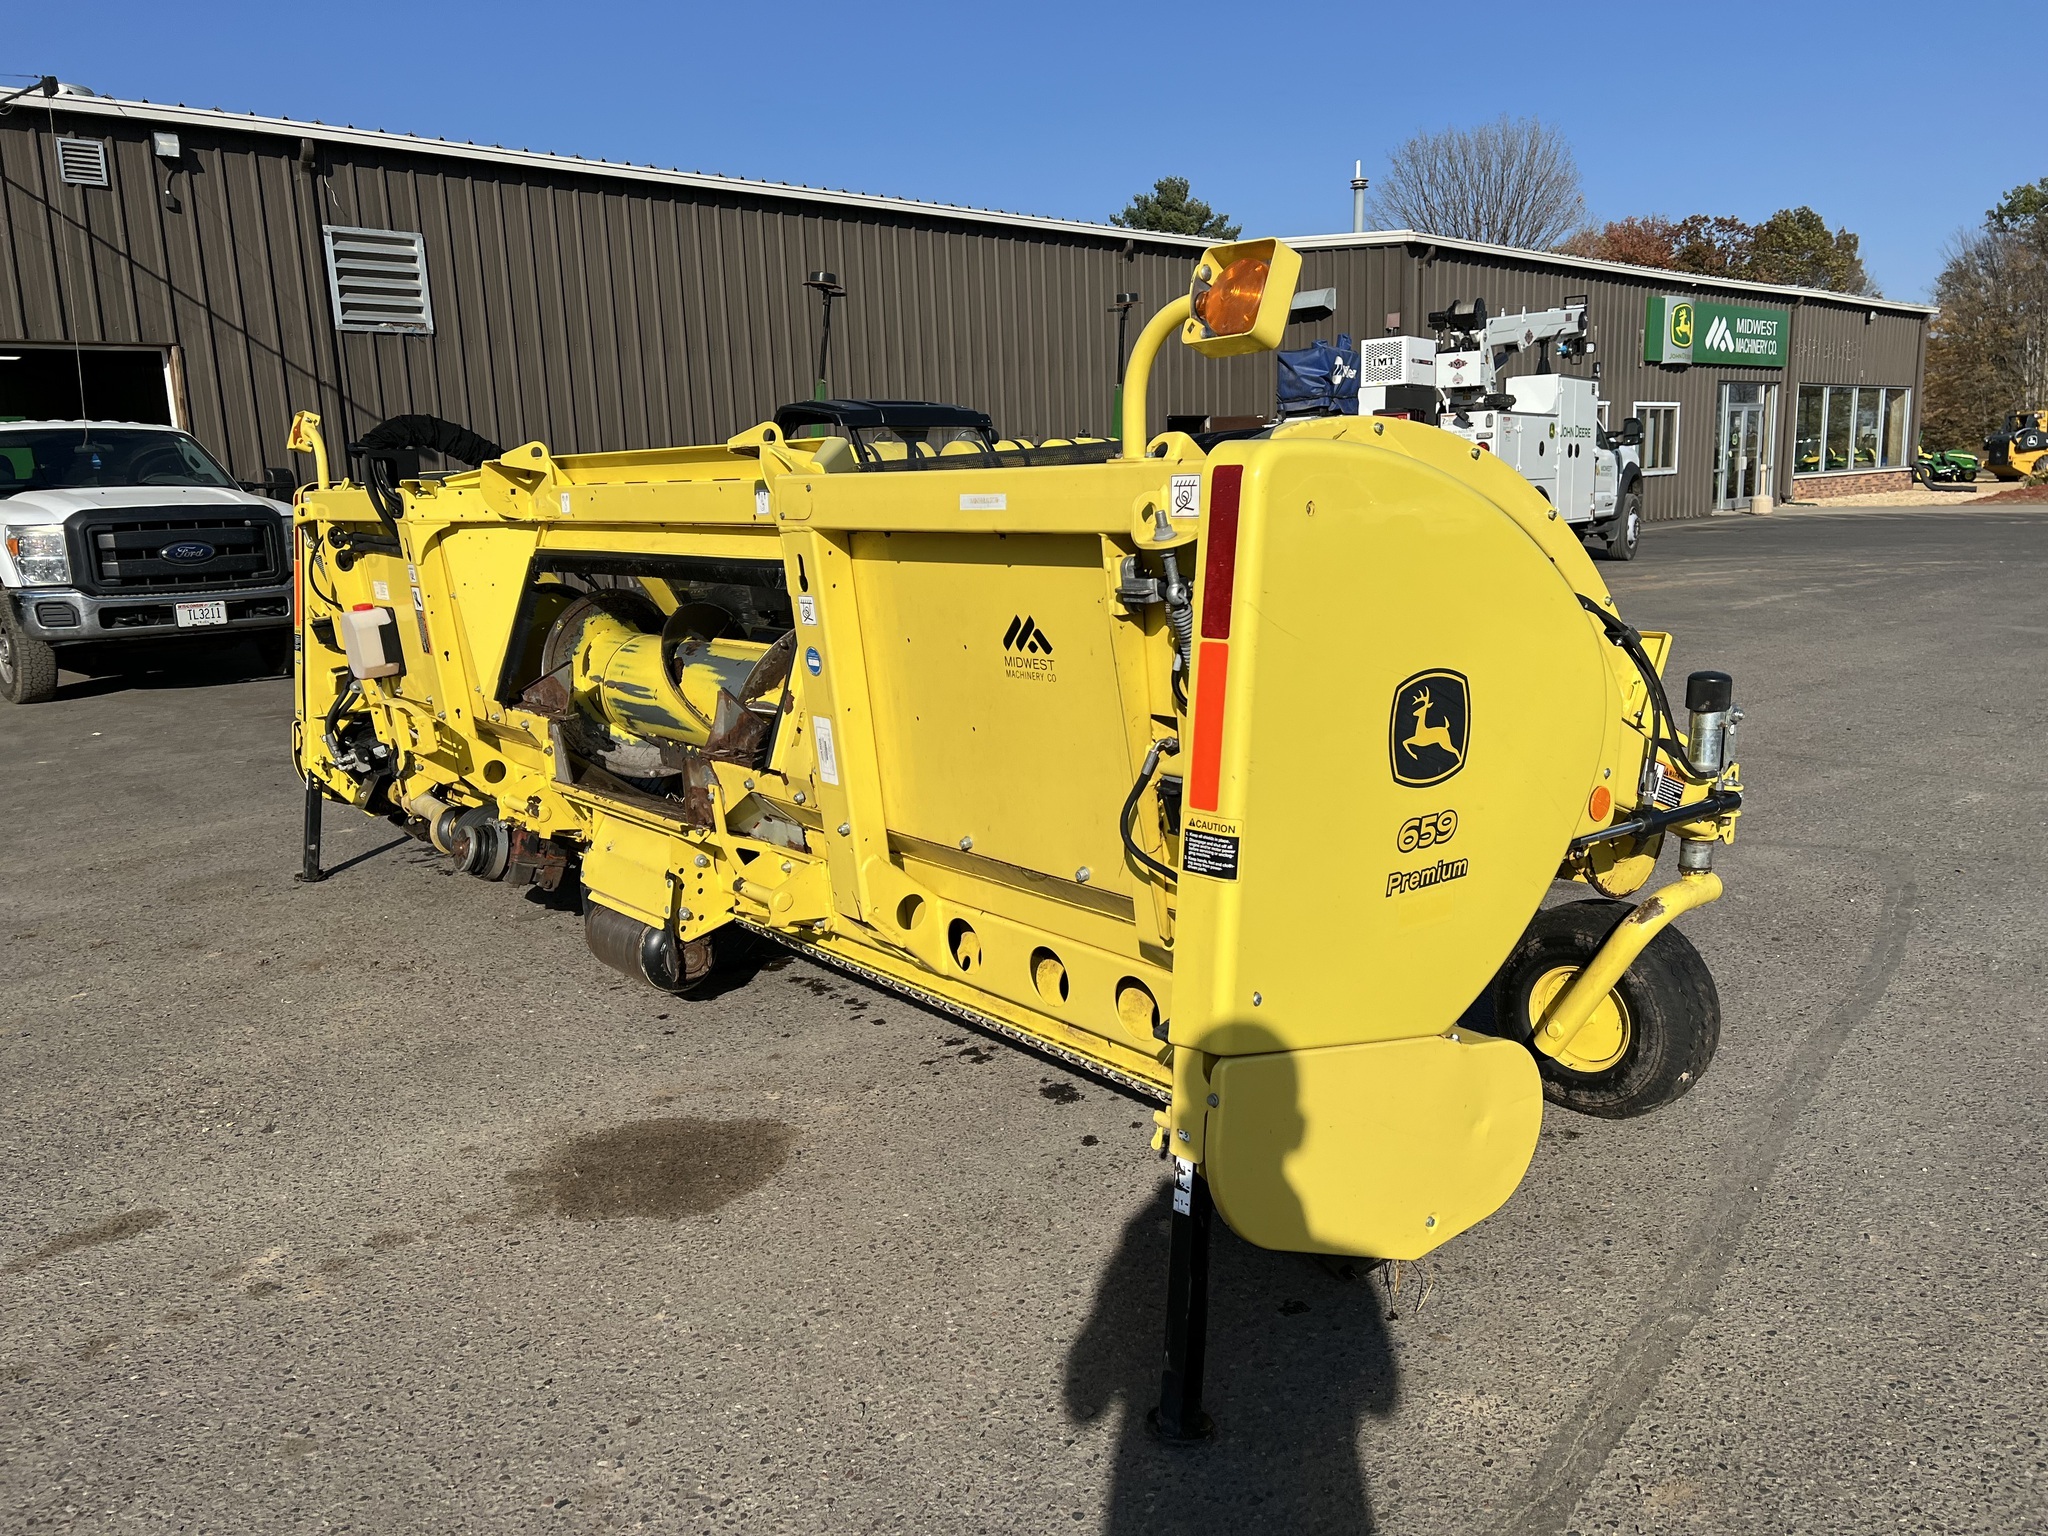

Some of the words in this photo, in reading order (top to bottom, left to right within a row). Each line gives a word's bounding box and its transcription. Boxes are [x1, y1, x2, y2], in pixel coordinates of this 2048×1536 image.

[1736, 318, 1778, 336] MIDWEST
[1736, 338, 1768, 354] MACHINERY
[1372, 357, 1395, 366] IMT
[1560, 424, 1574, 438] JOHN
[1575, 425, 1591, 438] DEERE
[175, 546, 204, 558] Ford
[187, 607, 221, 620] TL3211
[1004, 656, 1055, 671] MIDWEST
[1006, 670, 1044, 681] MACHINERY
[1047, 673, 1057, 682] CO
[1196, 819, 1236, 834] CAUTION
[1397, 809, 1458, 853] 659
[1386, 858, 1468, 898] Premium
